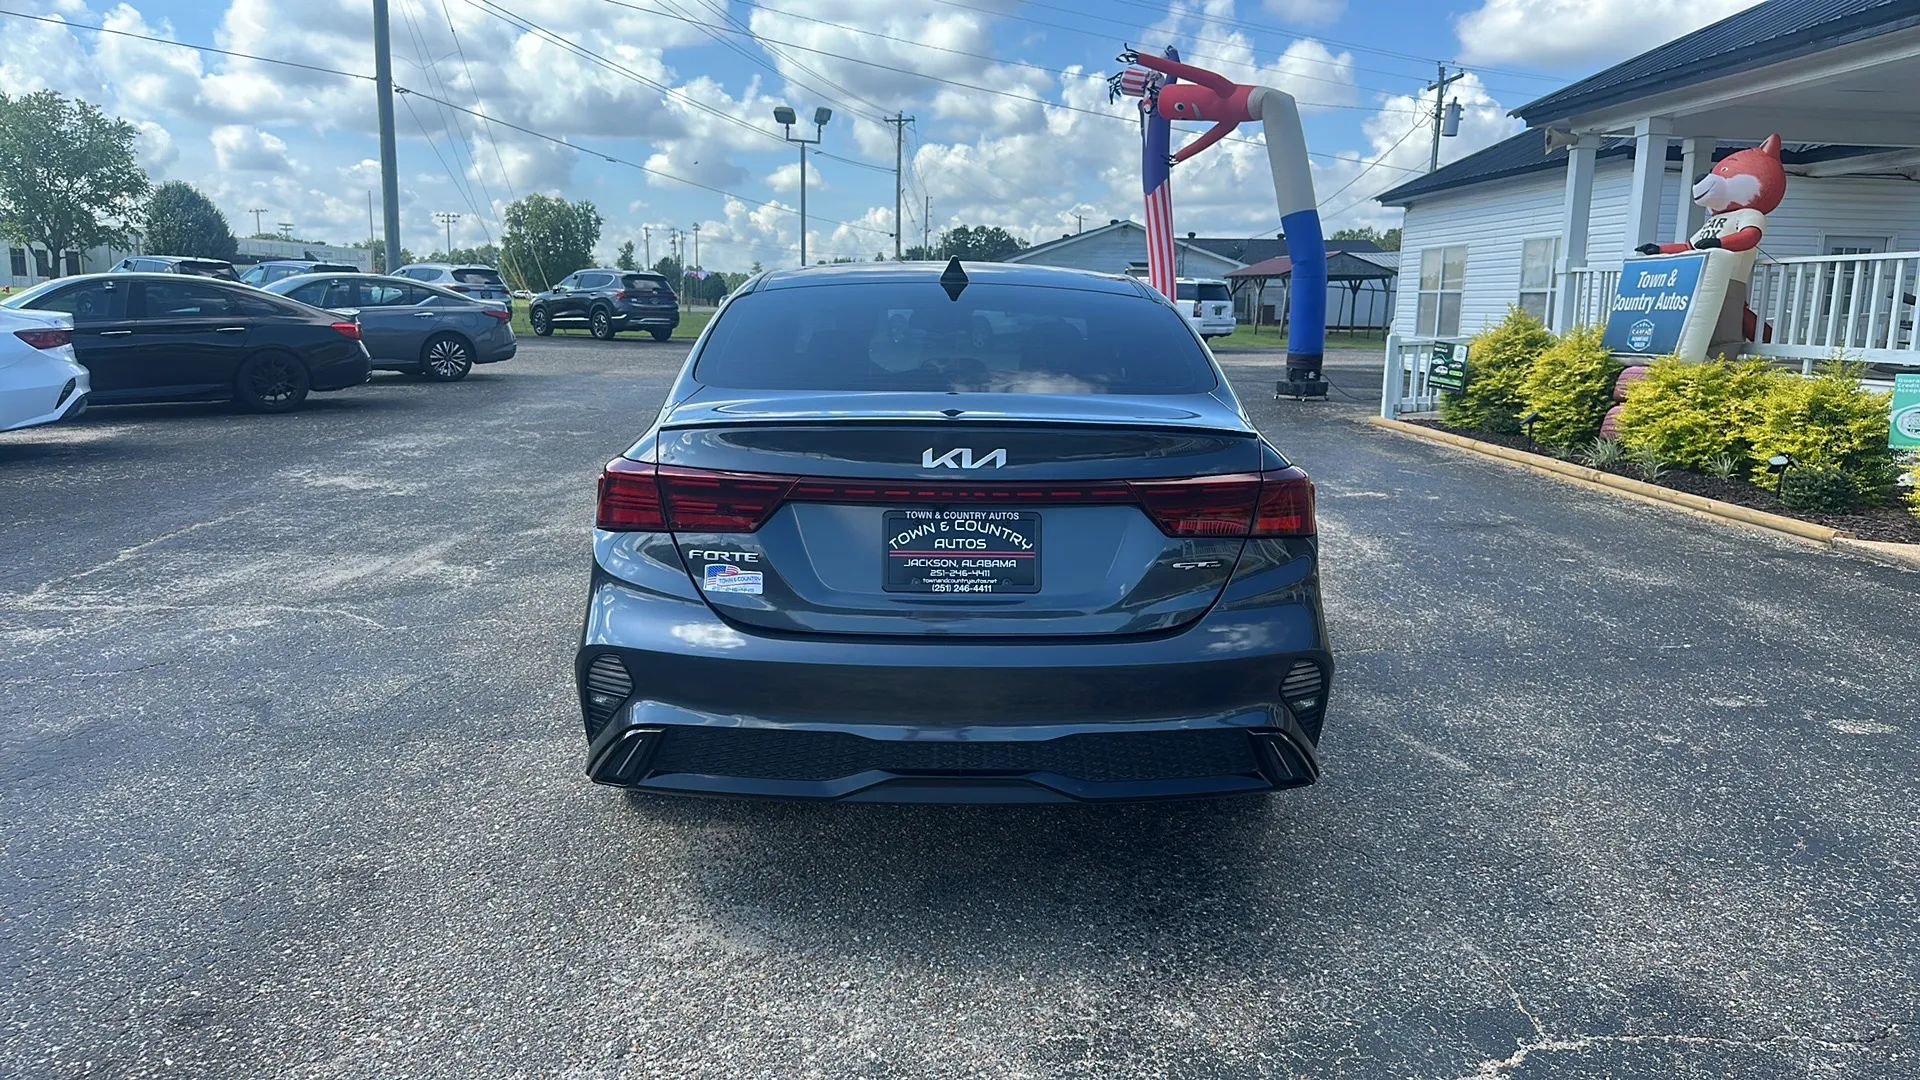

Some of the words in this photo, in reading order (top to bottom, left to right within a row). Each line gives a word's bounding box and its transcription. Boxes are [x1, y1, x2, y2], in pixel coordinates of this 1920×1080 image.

[1637, 271, 1667, 288] Town
[1667, 268, 1678, 287] &
[1612, 293, 1655, 314] Country
[1655, 292, 1689, 310] Autos
[922, 448, 1007, 469] KIA
[905, 511, 933, 519] TOWN
[935, 511, 941, 519] &
[943, 511, 987, 520] COUNTRY
[988, 512, 1020, 520] AUTOS
[888, 522, 936, 550] TOWN
[940, 521, 950, 532] &
[954, 519, 1033, 550] COUNTRY
[934, 538, 987, 549] AUTOS
[688, 549, 759, 563] FORTE
[903, 559, 959, 568] JACKSON,
[961, 559, 1017, 568] ALABAMA
[929, 569, 991, 577] 251-246-4411
[931, 584, 952, 592] (251)
[953, 584, 992, 593] 246-4411
